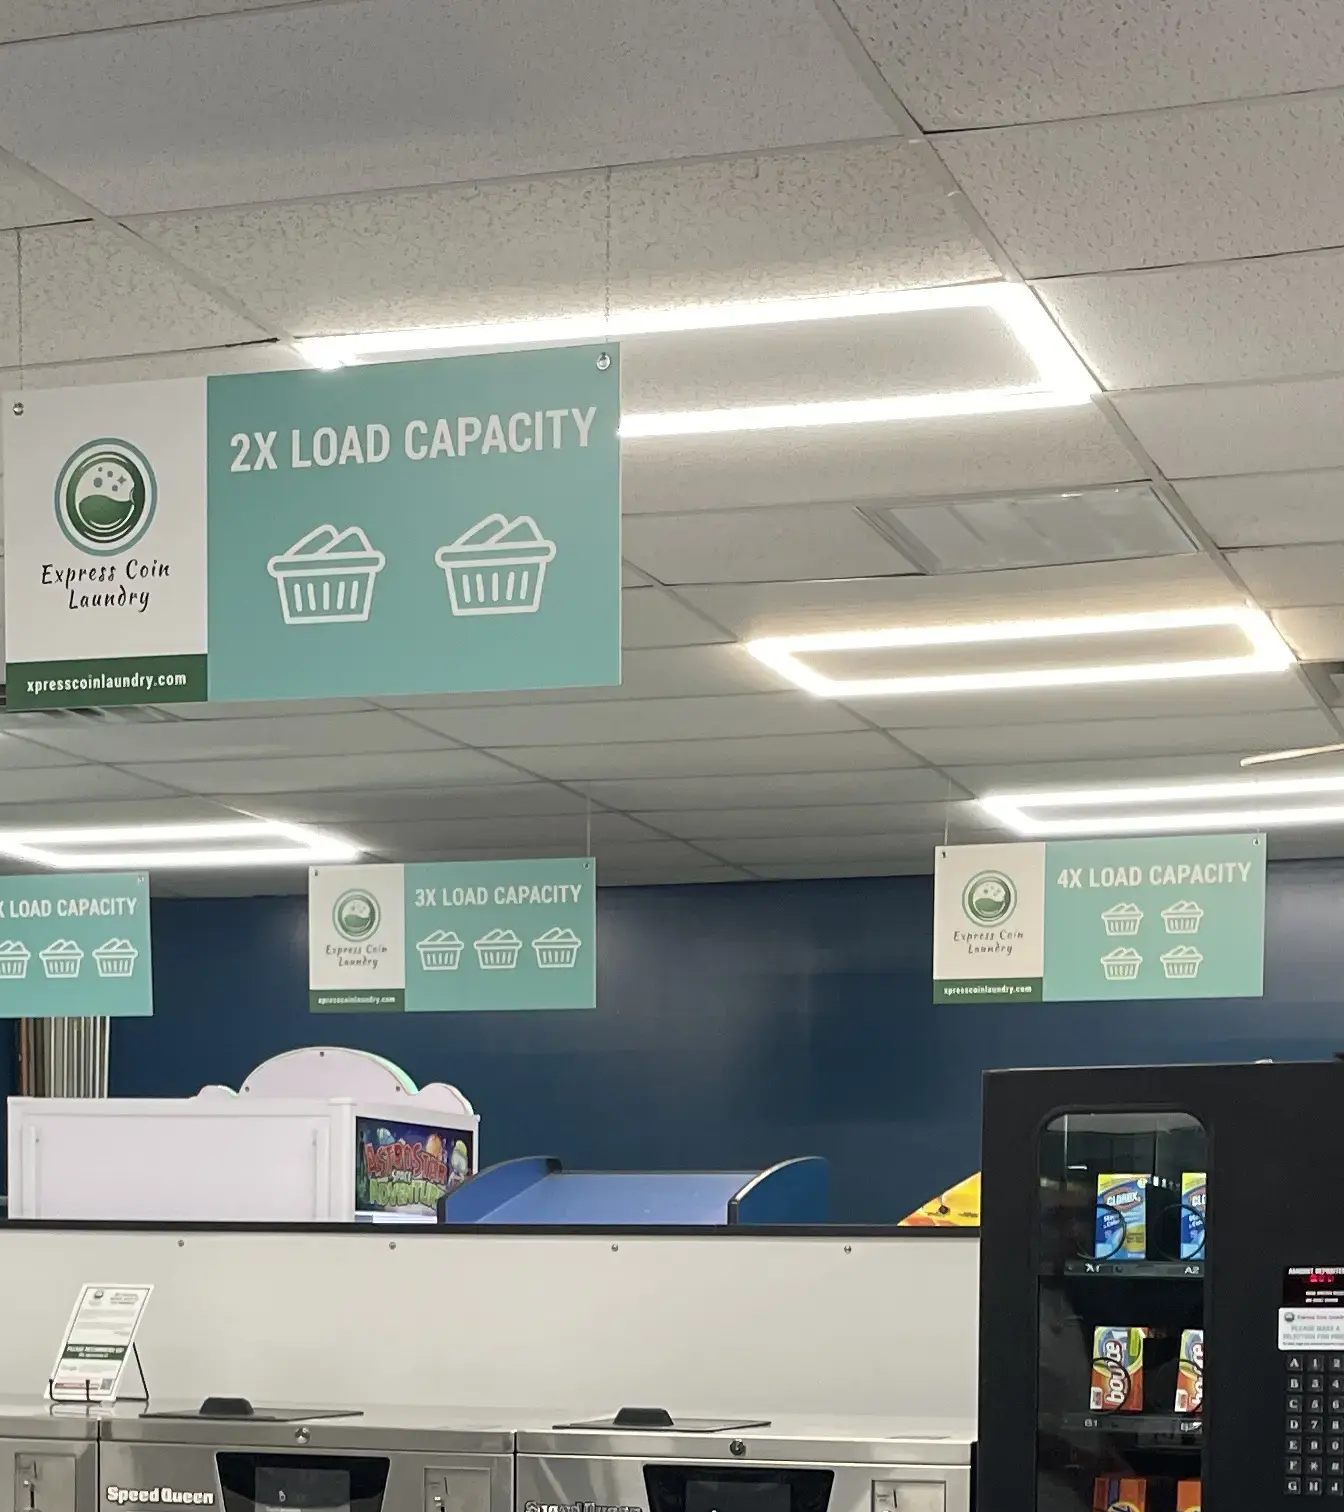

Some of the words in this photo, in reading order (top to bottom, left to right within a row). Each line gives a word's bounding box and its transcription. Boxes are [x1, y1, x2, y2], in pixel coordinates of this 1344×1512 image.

[229, 431, 278, 473] 2X
[291, 422, 391, 469] LOAD
[404, 405, 599, 461] CAPACITY
[40, 561, 117, 589] Express
[125, 557, 171, 581] Coin
[67, 584, 151, 613] Laundry
[26, 669, 187, 695] xpresscoinlaundry.com
[1056, 868, 1083, 889] 4X
[1088, 865, 1143, 887] LOAD
[1149, 861, 1253, 886] CAPACITY
[414, 888, 437, 907] 3X
[442, 886, 489, 906] LOAD
[493, 884, 583, 905] CAPACITY
[9, 898, 53, 918] LOAD
[57, 897, 138, 917] CAPACITY
[1290, 1358, 1299, 1368] A
[1313, 1358, 1318, 1368] 1
[1332, 1379, 1339, 1388] 4
[1289, 1400, 1298, 1408] C
[1290, 1420, 1298, 1429] D
[1311, 1420, 1318, 1429] 7
[1289, 1440, 1297, 1450] E
[106, 1486, 159, 1506] Speed
[160, 1487, 215, 1506] Queen
[1288, 1481, 1297, 1491] G
[1331, 1482, 1338, 1491] J
